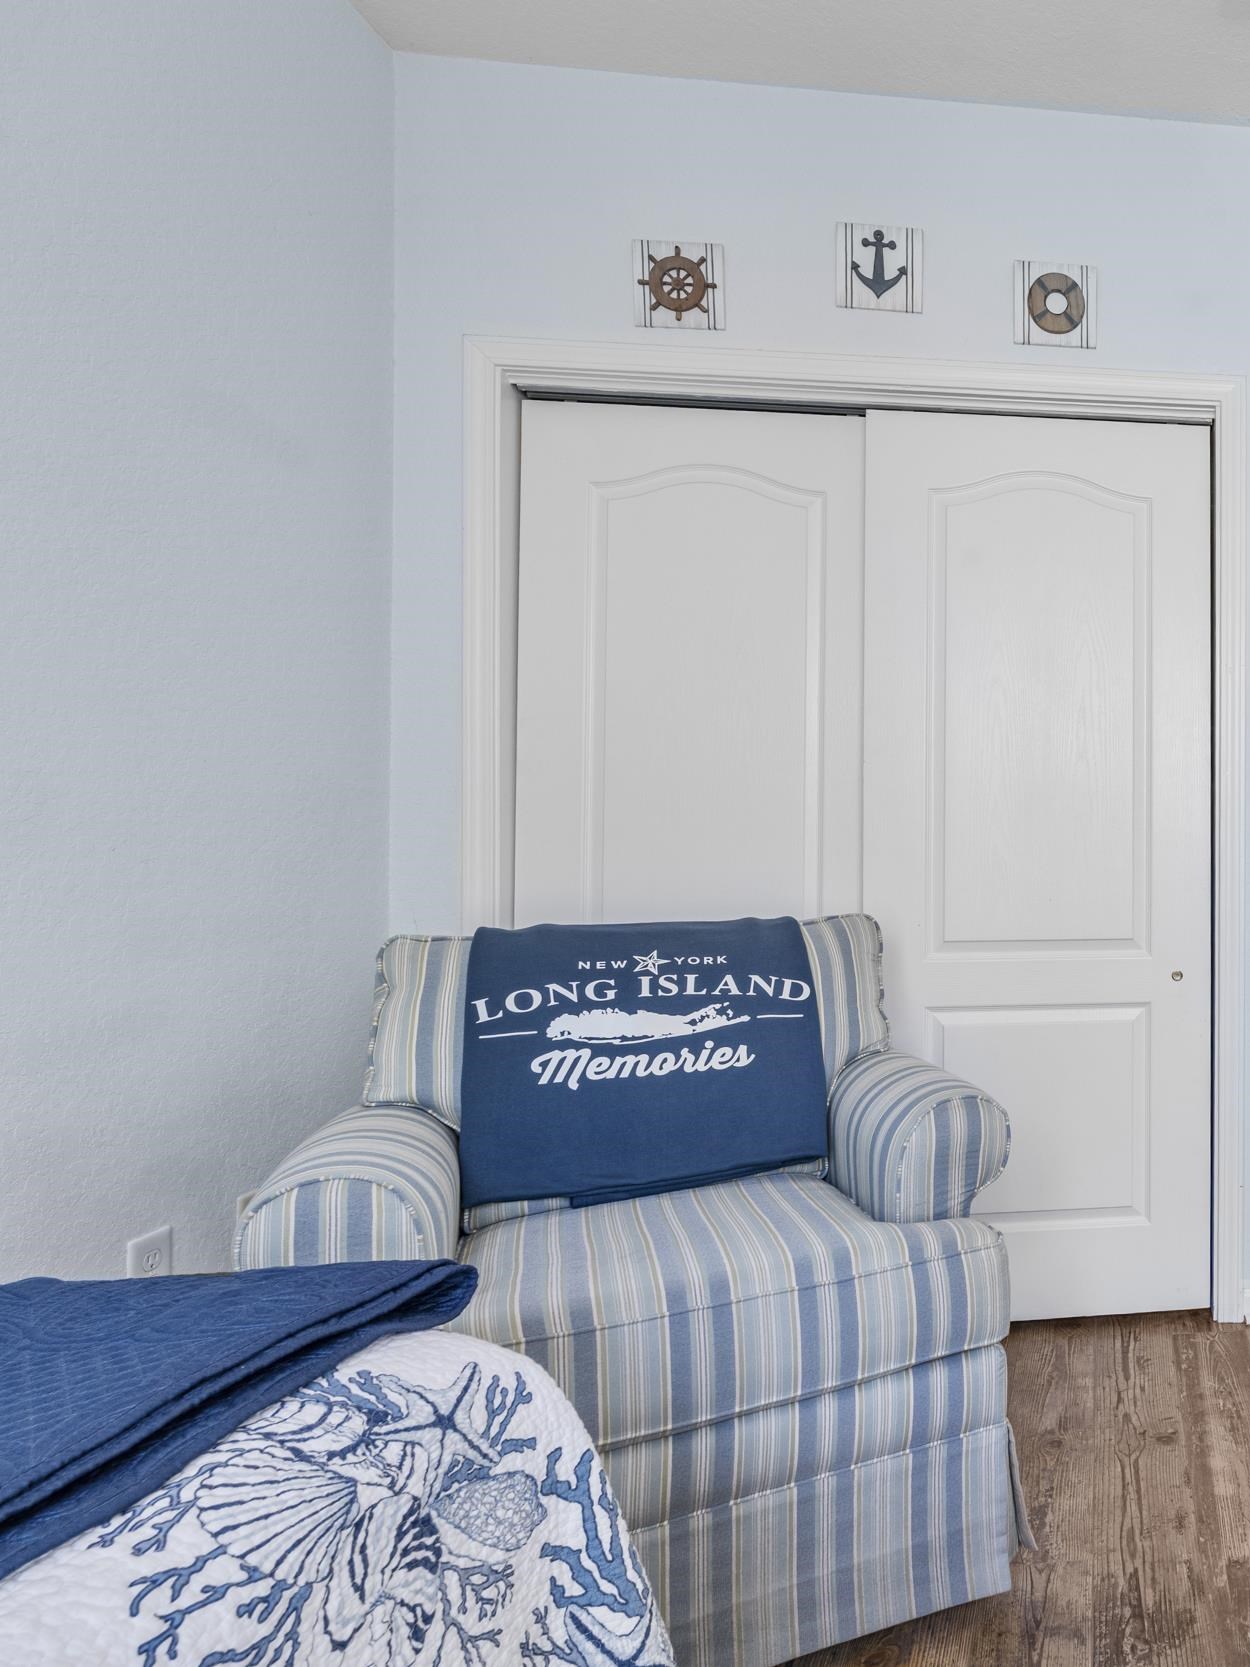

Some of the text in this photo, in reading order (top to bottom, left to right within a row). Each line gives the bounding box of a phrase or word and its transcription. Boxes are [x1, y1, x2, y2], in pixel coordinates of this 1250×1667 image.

[577, 955, 728, 970] NEW YORK
[470, 974, 811, 1024] LONG ISLAND
[530, 1040, 756, 1091] Memories
